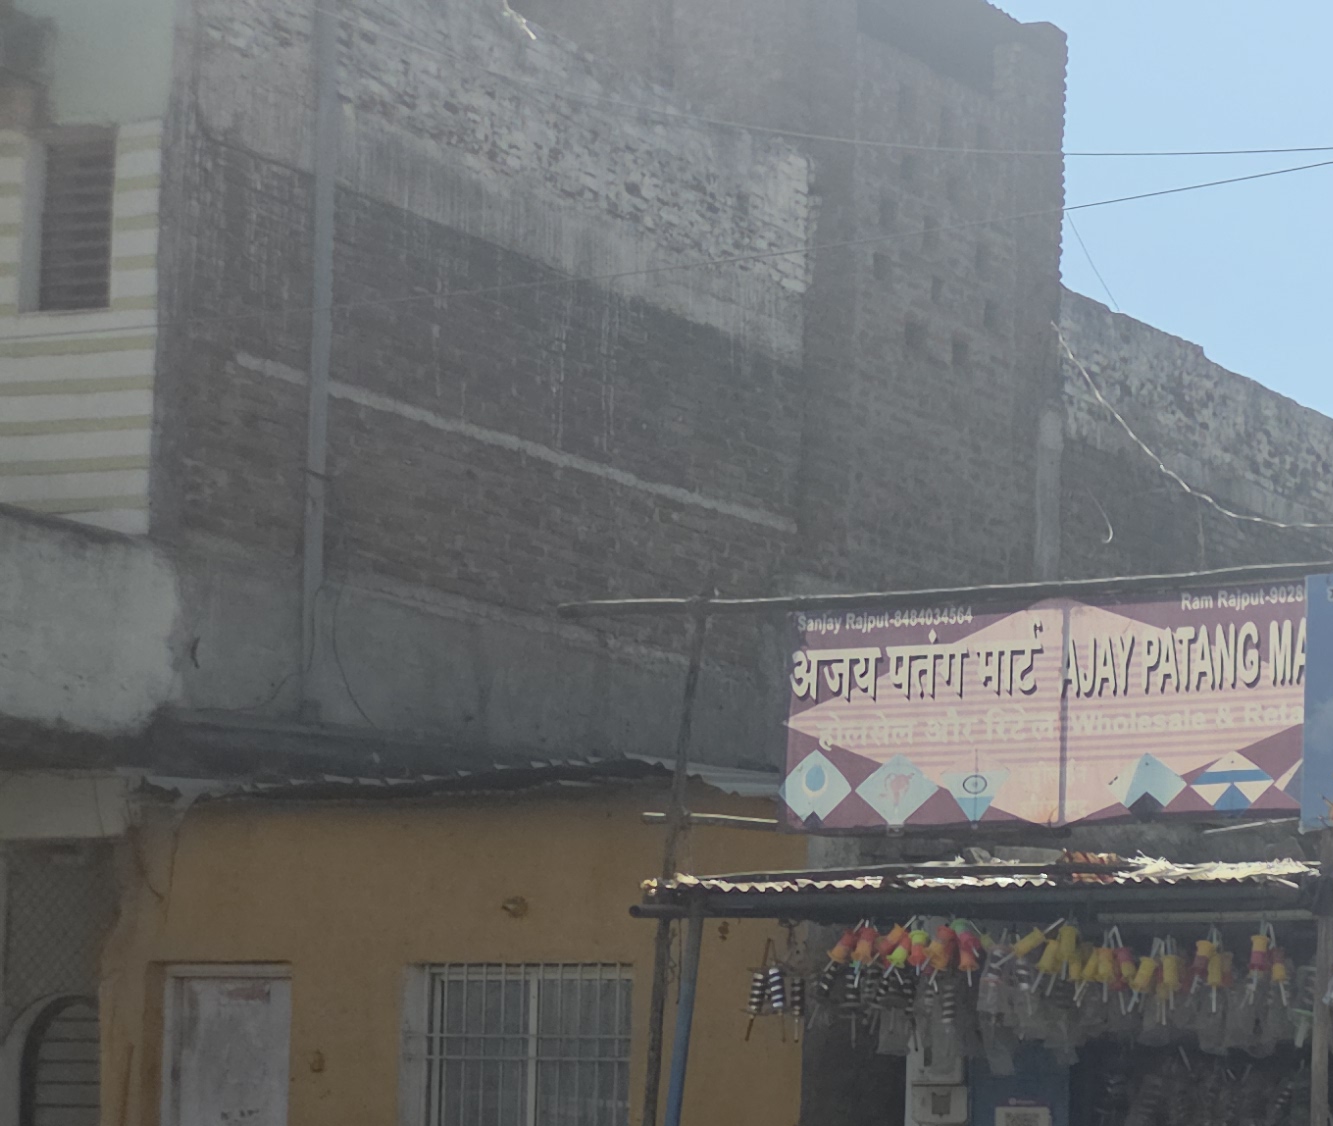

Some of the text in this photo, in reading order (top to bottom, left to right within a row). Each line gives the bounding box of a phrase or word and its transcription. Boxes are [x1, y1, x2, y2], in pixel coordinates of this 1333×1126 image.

[1181, 585, 1305, 611] Ram Rajput-9028
[797, 614, 841, 635] Sanjay
[790, 646, 882, 702] अजय
[886, 630, 968, 700] पतंग
[976, 625, 1044, 696] मार्ट
[1061, 630, 1141, 698] AJAY
[1142, 622, 1259, 694] PATANG
[816, 710, 914, 751] होलसेल
[924, 707, 978, 743] और
[1070, 706, 1206, 736] Wholesale
[1216, 705, 1234, 729] &
